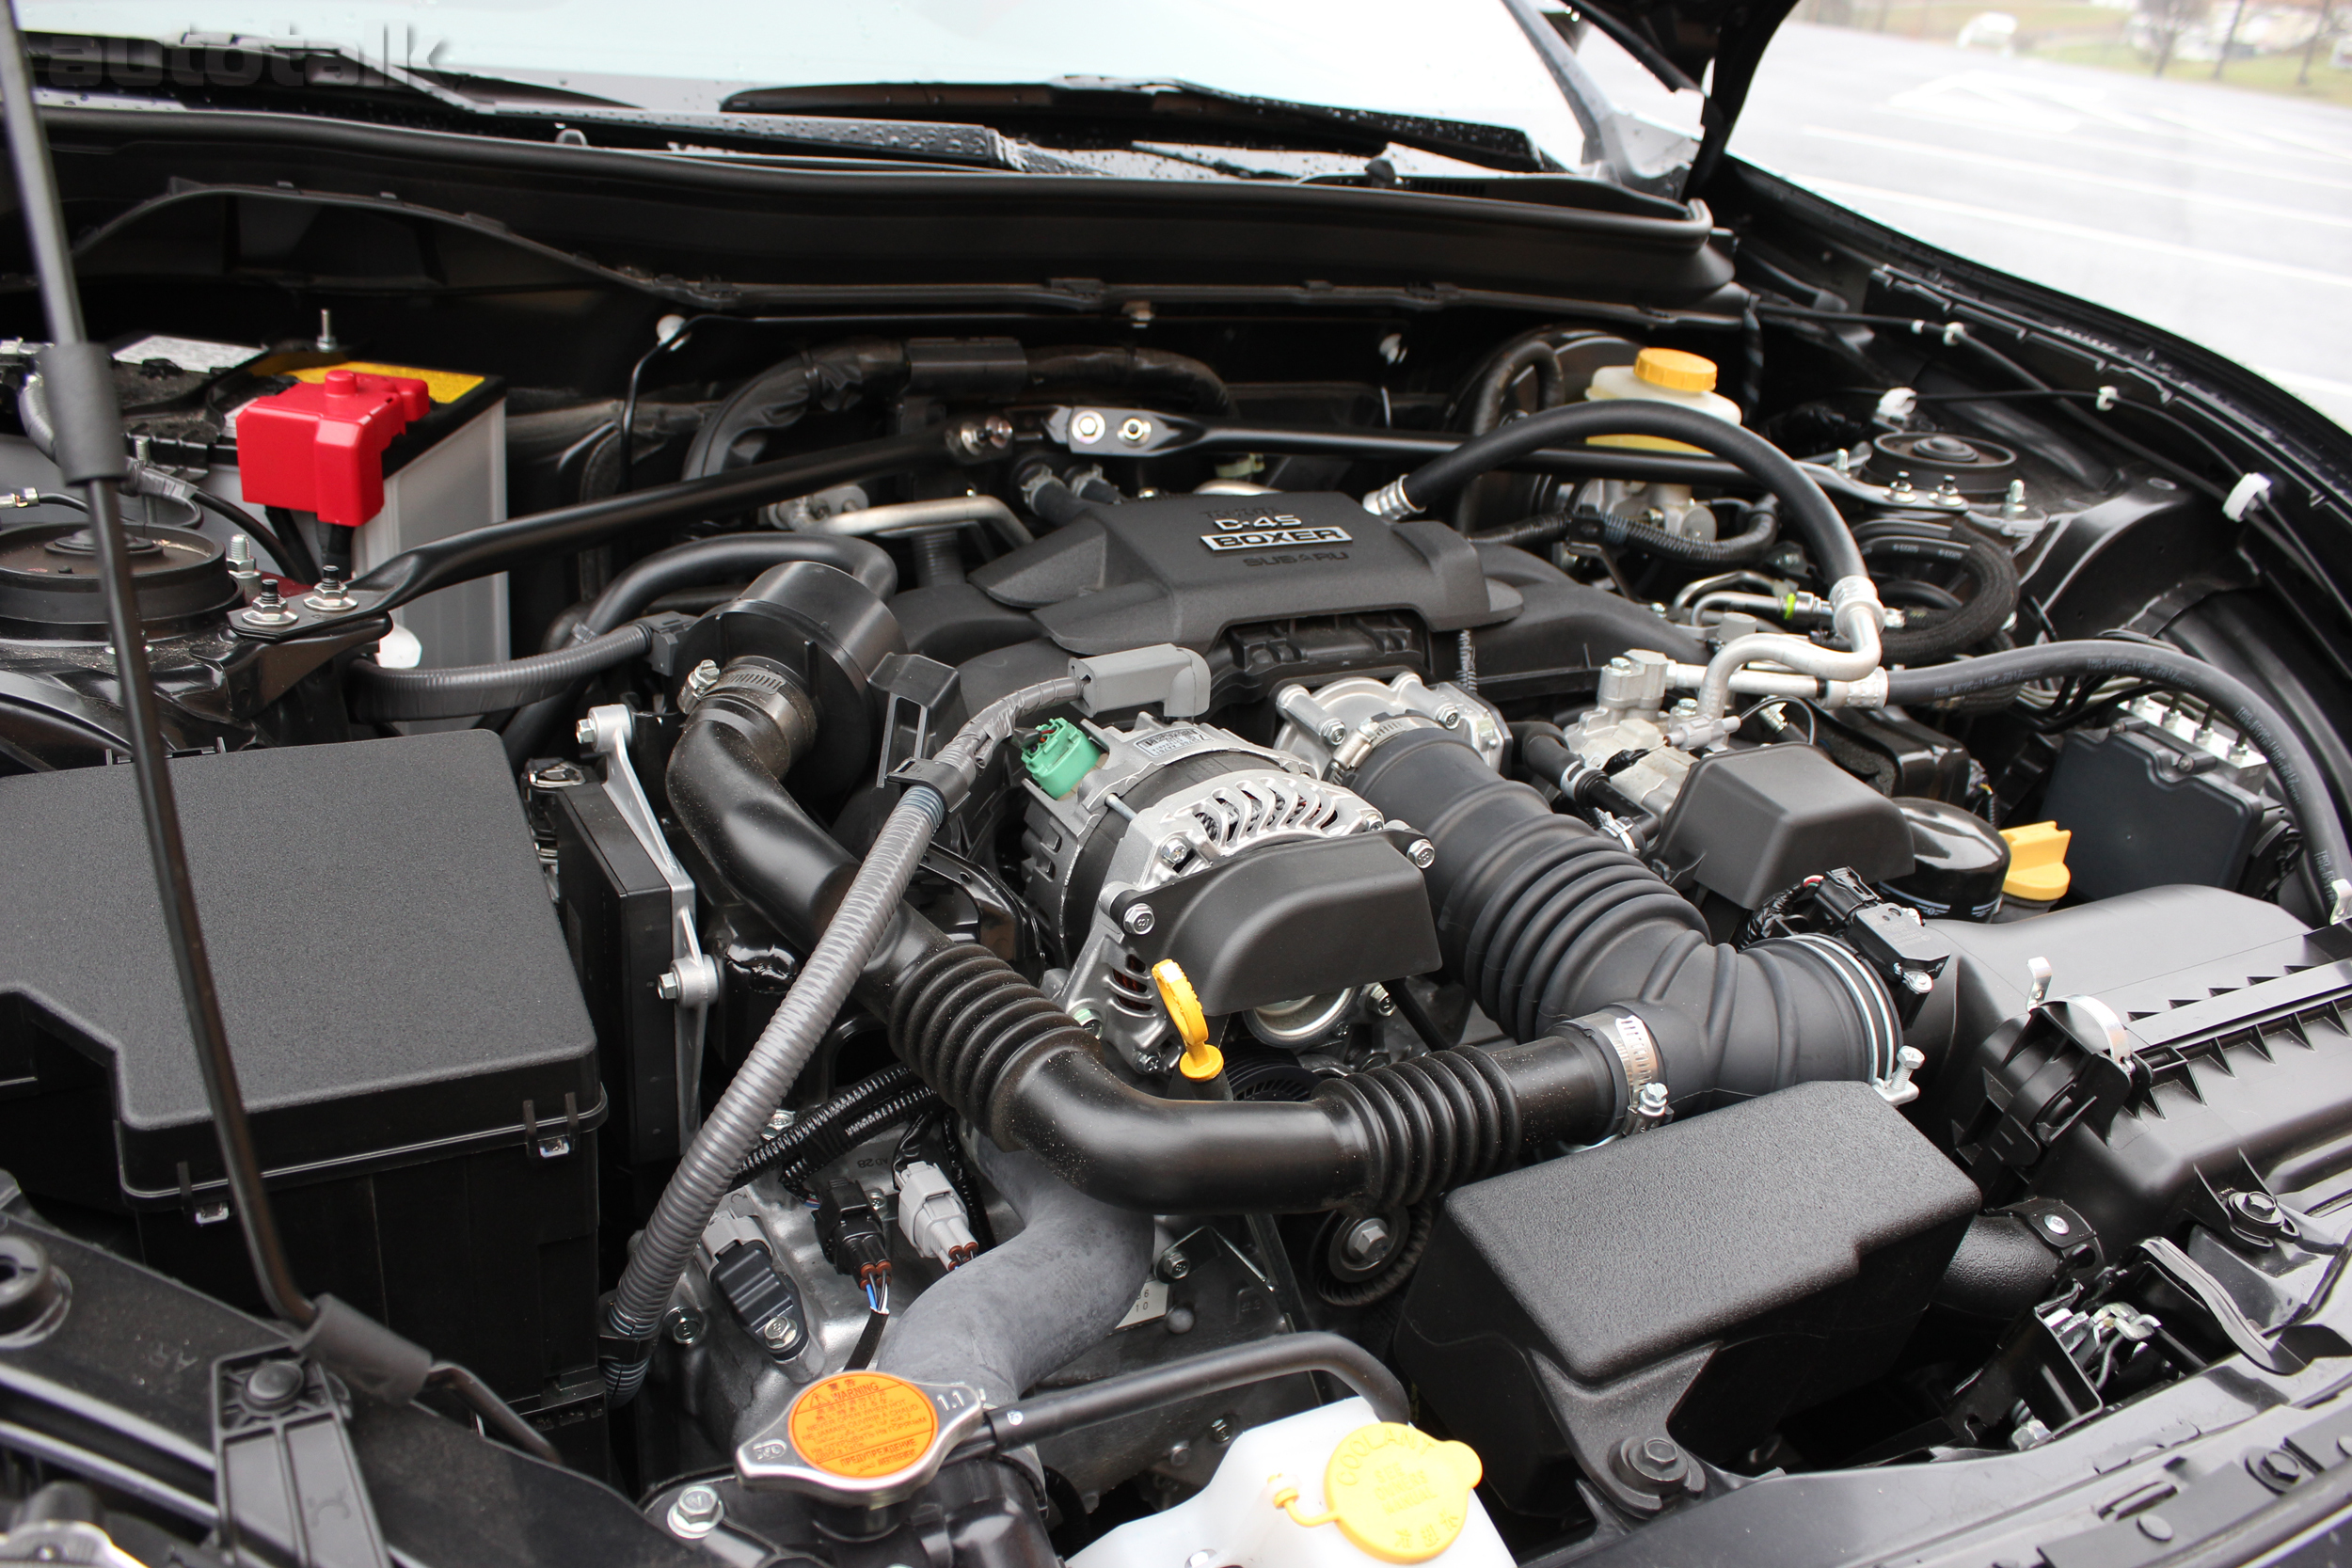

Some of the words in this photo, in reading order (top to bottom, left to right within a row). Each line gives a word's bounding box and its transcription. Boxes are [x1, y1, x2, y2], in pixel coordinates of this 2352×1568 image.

[1212, 529, 1343, 547] BOXER
[1243, 551, 1349, 567] SUBARU
[857, 1158, 874, 1169] 28
[830, 1382, 879, 1402] WARNING
[937, 1389, 965, 1412] 1.1
[802, 1432, 814, 1442] NE
[816, 1423, 847, 1439] JAMAIS
[848, 1414, 880, 1430] OUVRIR
[889, 1403, 919, 1418] CHAUD
[806, 1416, 835, 1433] NEVER
[837, 1411, 862, 1424] OPEN
[863, 1404, 888, 1418] WHEN
[889, 1399, 907, 1412] HOT
[840, 1437, 917, 1466] ПРЕДУПРЕЖДЕНИЕ
[1336, 1428, 1437, 1486] COOLANT
[1374, 1461, 1406, 1483] SEE
[1374, 1469, 1429, 1501] OWNERS
[1381, 1485, 1438, 1516] MANUAL
